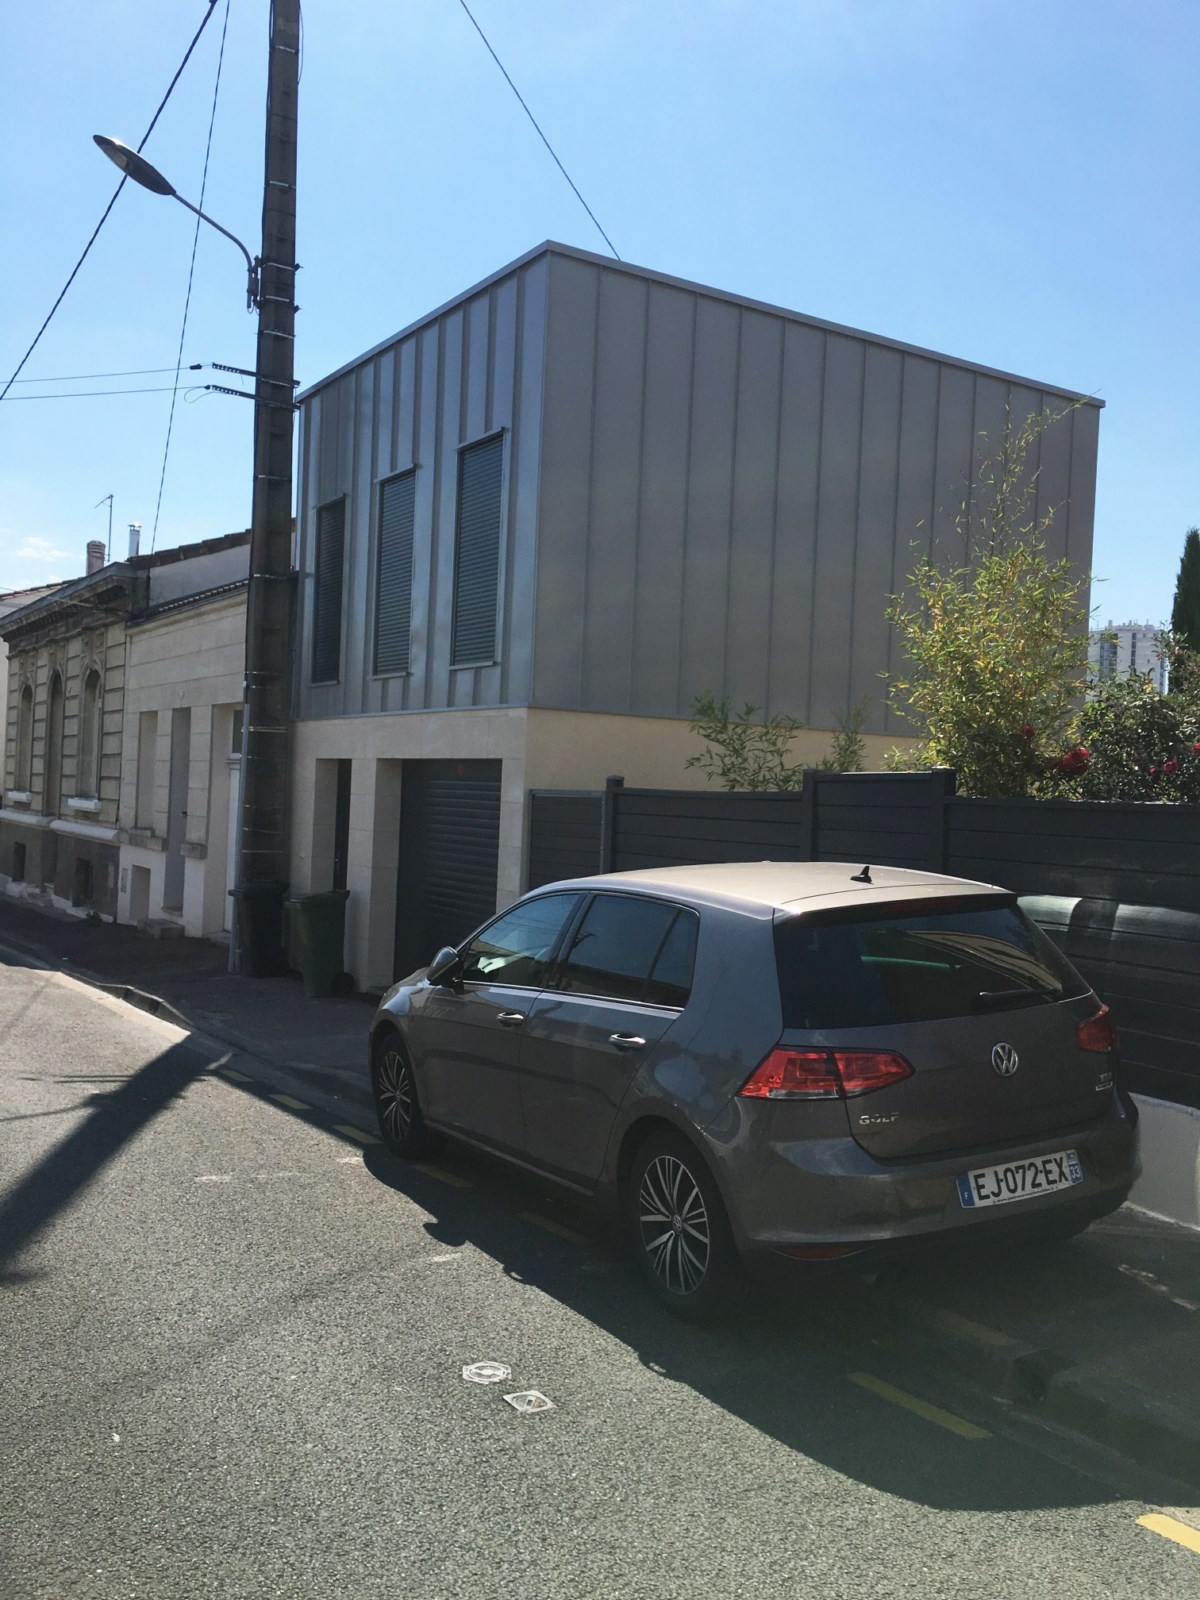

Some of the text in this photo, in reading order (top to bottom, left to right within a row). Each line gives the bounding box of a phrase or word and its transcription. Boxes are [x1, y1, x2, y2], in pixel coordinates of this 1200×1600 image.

[992, 1042, 1019, 1077] VW
[859, 1112, 899, 1125] GOLF
[1069, 1164, 1081, 1180] 33
